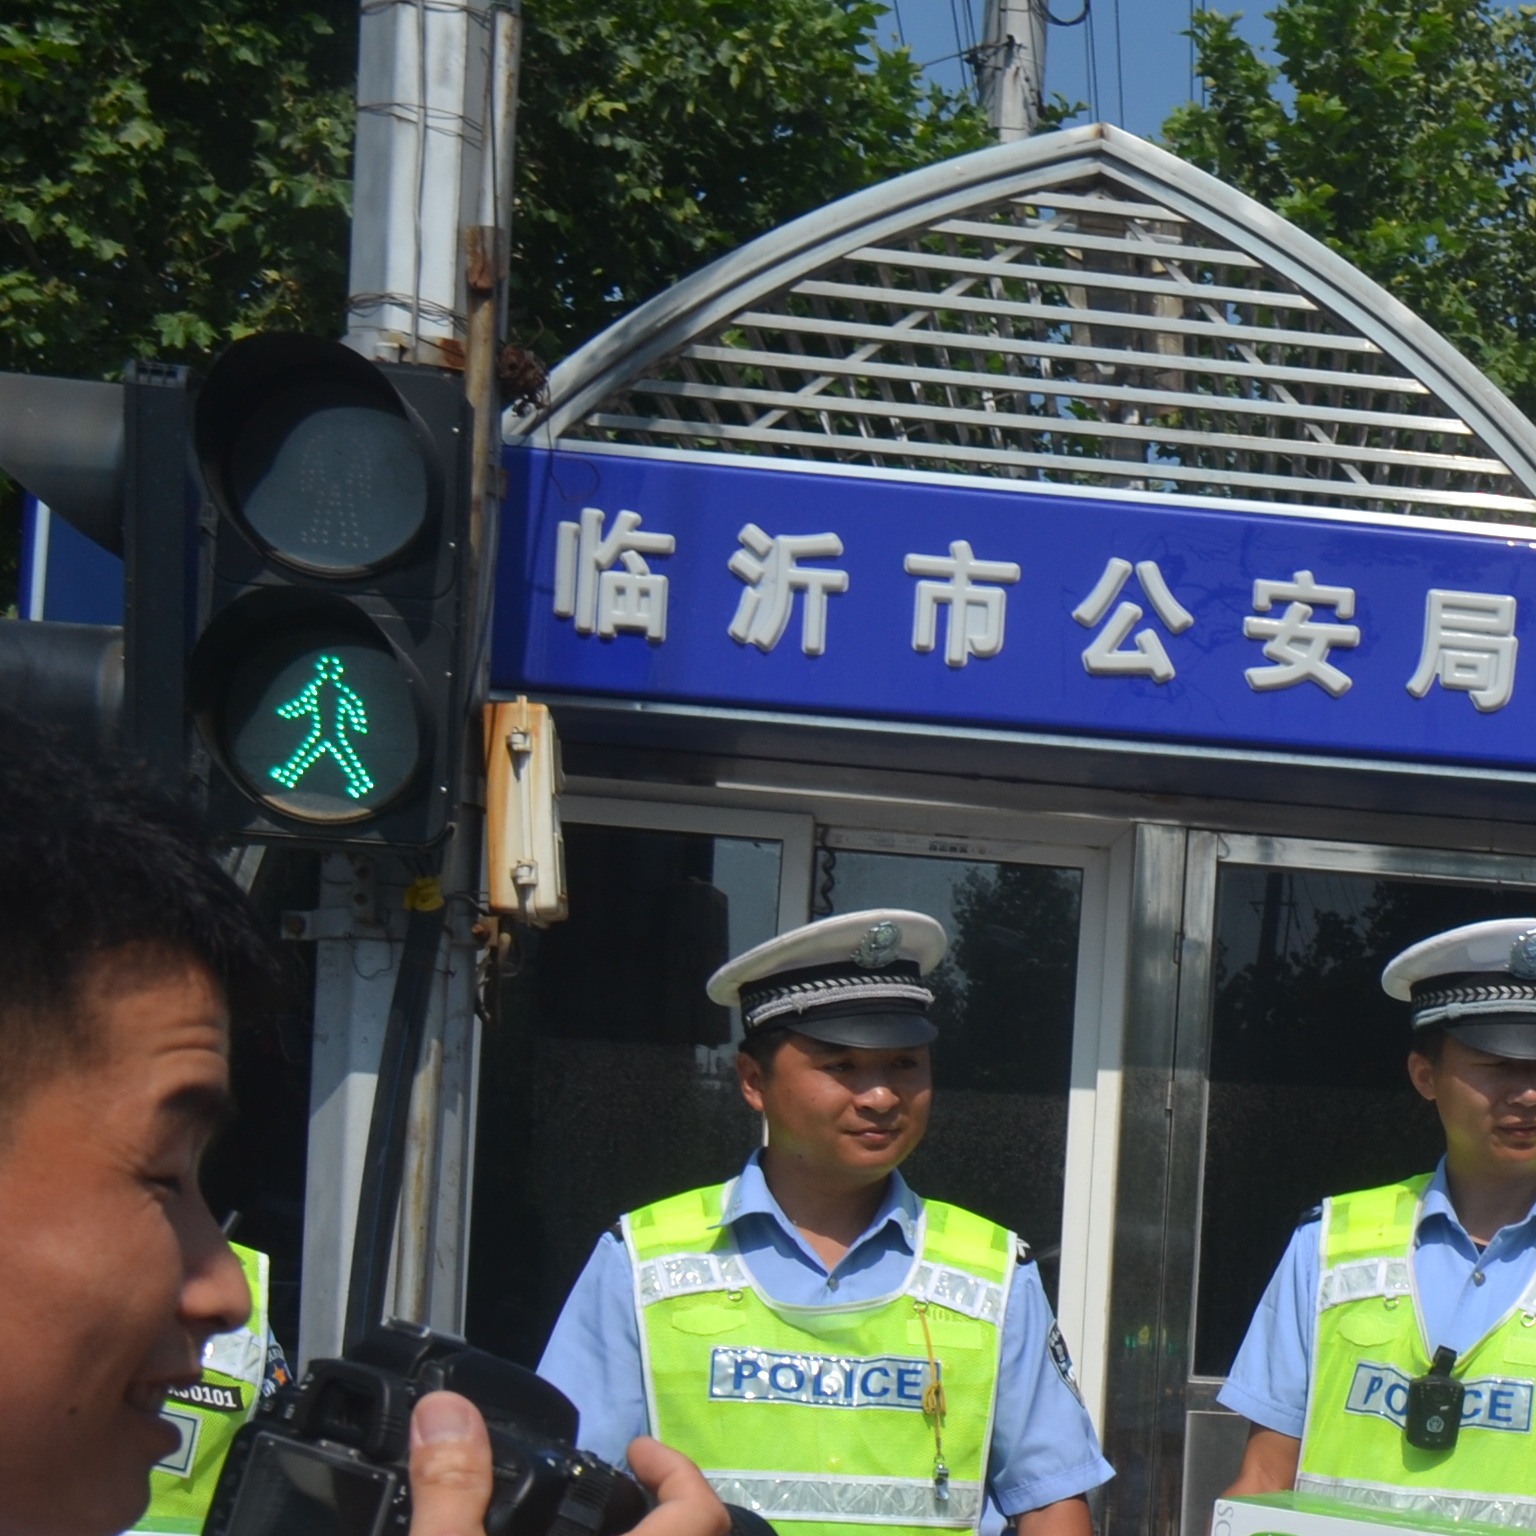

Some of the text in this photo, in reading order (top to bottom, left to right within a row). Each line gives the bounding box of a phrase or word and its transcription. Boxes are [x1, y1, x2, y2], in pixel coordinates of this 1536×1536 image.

[555, 508, 1519, 713] 临沂市公安局
[732, 1357, 925, 1401] POLICE
[1362, 1375, 1514, 1422] POCE
